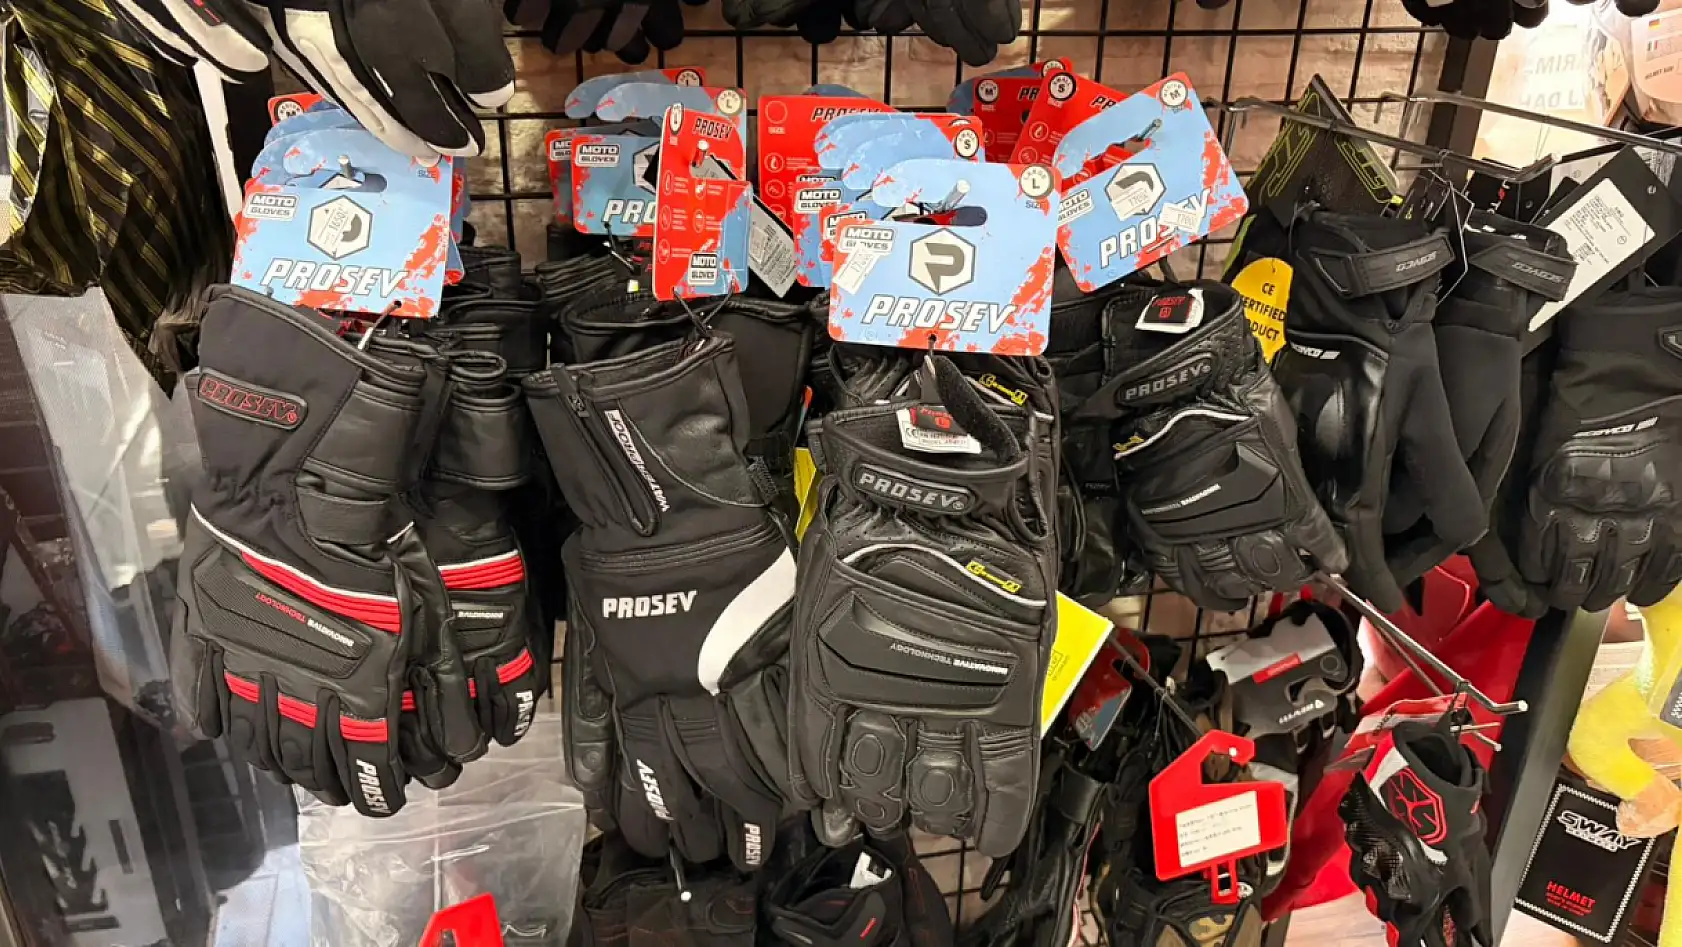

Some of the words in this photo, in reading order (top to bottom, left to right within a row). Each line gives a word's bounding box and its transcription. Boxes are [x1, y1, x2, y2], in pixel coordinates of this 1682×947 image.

[693, 117, 733, 139] PROSEV
[581, 145, 618, 155] MOTO
[1031, 177, 1041, 190] L
[251, 194, 296, 206] MOTO
[800, 189, 839, 201] MOTO
[250, 206, 292, 217] GLOVES
[846, 227, 893, 240] MOTO
[691, 255, 716, 267] MOTO
[259, 257, 409, 299] PROSEV
[1261, 281, 1276, 297] CE
[861, 293, 1018, 334] PROSEV
[1125, 366, 1203, 400] PROSEV
[200, 376, 293, 421] PROSEV
[859, 471, 958, 508] PROSEV
[602, 588, 698, 619] PROSEV
[889, 641, 952, 667] TECHNOLOGY
[1546, 880, 1597, 909] HELMET
